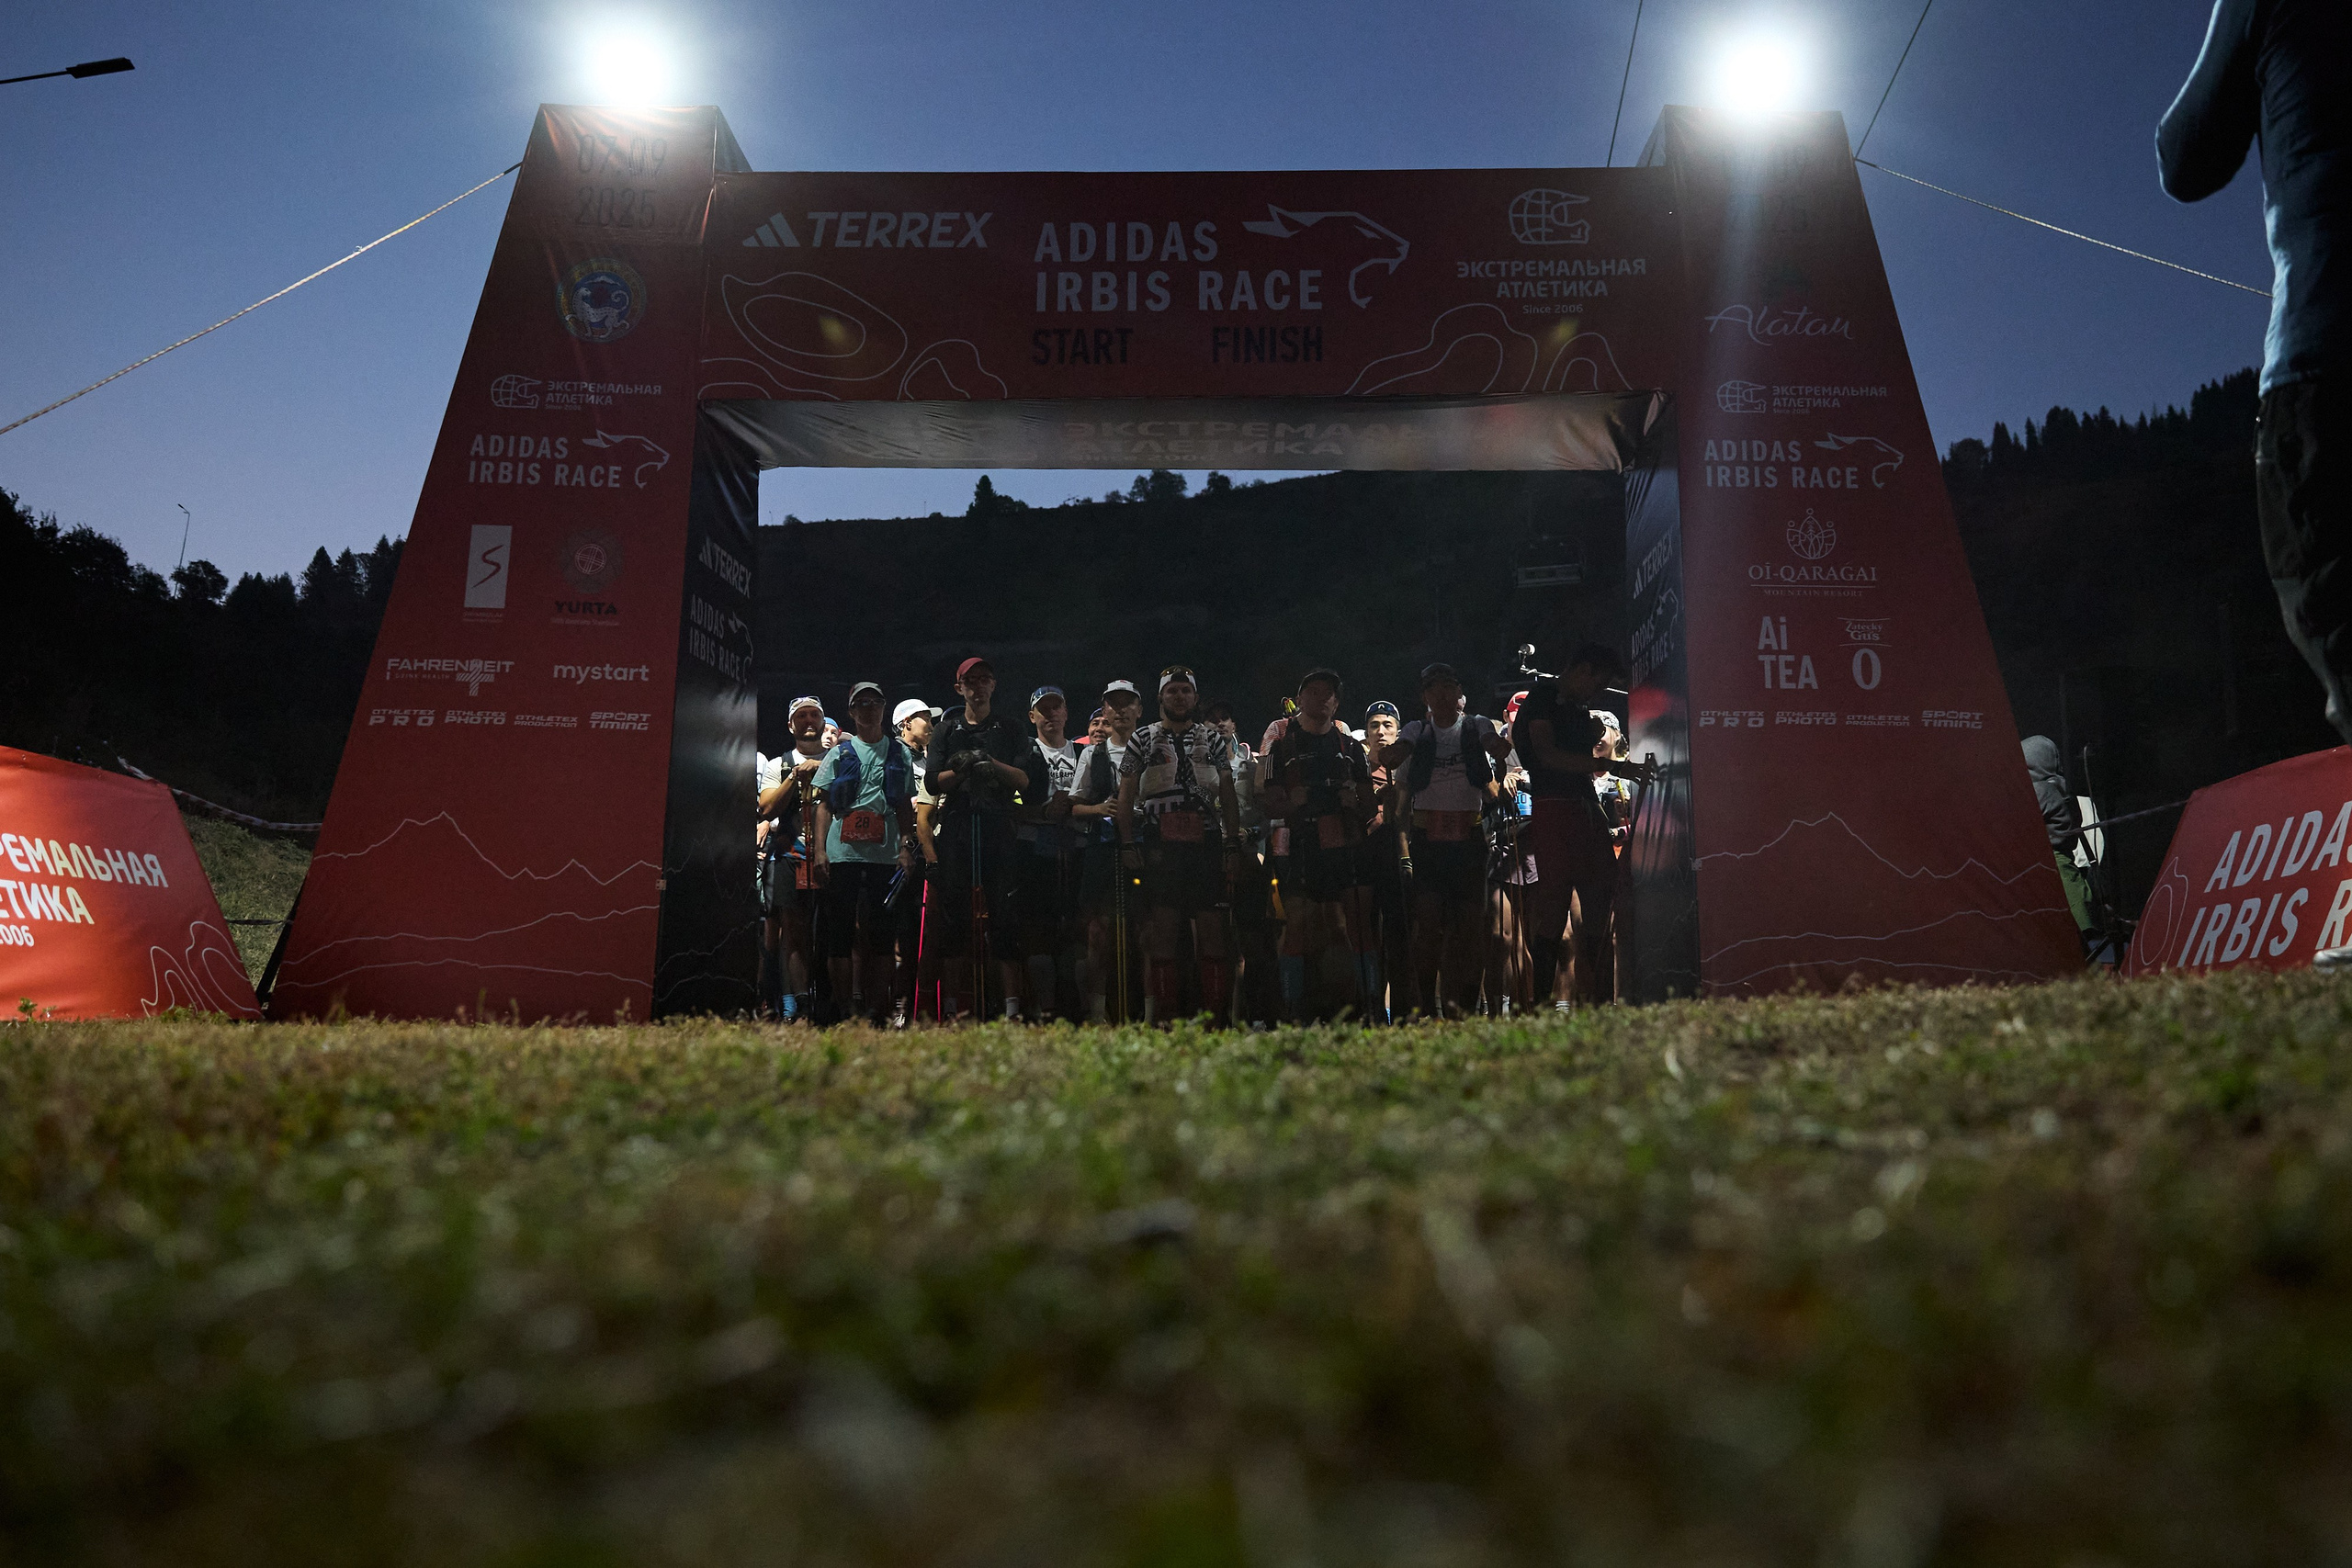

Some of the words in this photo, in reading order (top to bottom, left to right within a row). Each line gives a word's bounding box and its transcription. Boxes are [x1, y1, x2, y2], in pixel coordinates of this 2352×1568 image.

[574, 186, 656, 230] 2025
[807, 211, 994, 248] TERREX
[1034, 220, 1218, 263] ADIDAS
[1456, 258, 1646, 278] ЭКСТРЕМАЛЬНАЯ
[1035, 270, 1171, 312] IRBIS
[1198, 269, 1323, 311] RACE
[1496, 279, 1609, 299] АТЛЕТИКА
[1522, 304, 1552, 314] Since
[1555, 304, 1584, 313] 2006
[1032, 327, 1135, 367] START
[1211, 325, 1324, 364] FINISH
[548, 380, 662, 395] ЭКСТРЕМАЛЬНАЯ
[1772, 385, 1887, 397] ЭКСТРЕМАЛЬНАЯ
[545, 393, 613, 405] АТЛЕТИКА
[1772, 397, 1840, 408] АТЛЕТИКА
[469, 434, 569, 459] ADIDAS
[1703, 439, 1802, 462] ADIDAS
[468, 460, 541, 485] IRBIS
[554, 463, 622, 488] RACE
[1705, 465, 1779, 489] IRBIS
[1792, 466, 1860, 490] RACE
[713, 542, 752, 598] TERREX
[554, 601, 618, 615] YURTA
[690, 593, 725, 640] ADIDAS
[1758, 615, 1788, 650] Ai
[689, 626, 716, 667] IRBIS
[718, 645, 741, 682] RACE
[387, 658, 515, 673] FAHRENHEIT
[553, 663, 650, 685] mystart
[1758, 655, 1819, 689] TEA
[368, 716, 435, 727] PRO
[445, 715, 506, 725] PHOTO
[514, 720, 578, 728] PRODUCTION
[589, 720, 649, 731] TIMING
[590, 711, 651, 721] SPORT
[1700, 716, 1765, 728] PRO
[1775, 716, 1837, 726] PHOTO
[1922, 710, 1984, 719] SPORT
[1922, 718, 1983, 729] TIMING
[2204, 801, 2352, 893] ADIDA
[0, 833, 169, 887] ЕМАЛЬНАЯ
[0, 923, 35, 947] 006
[2177, 887, 2309, 967] IRBIS
